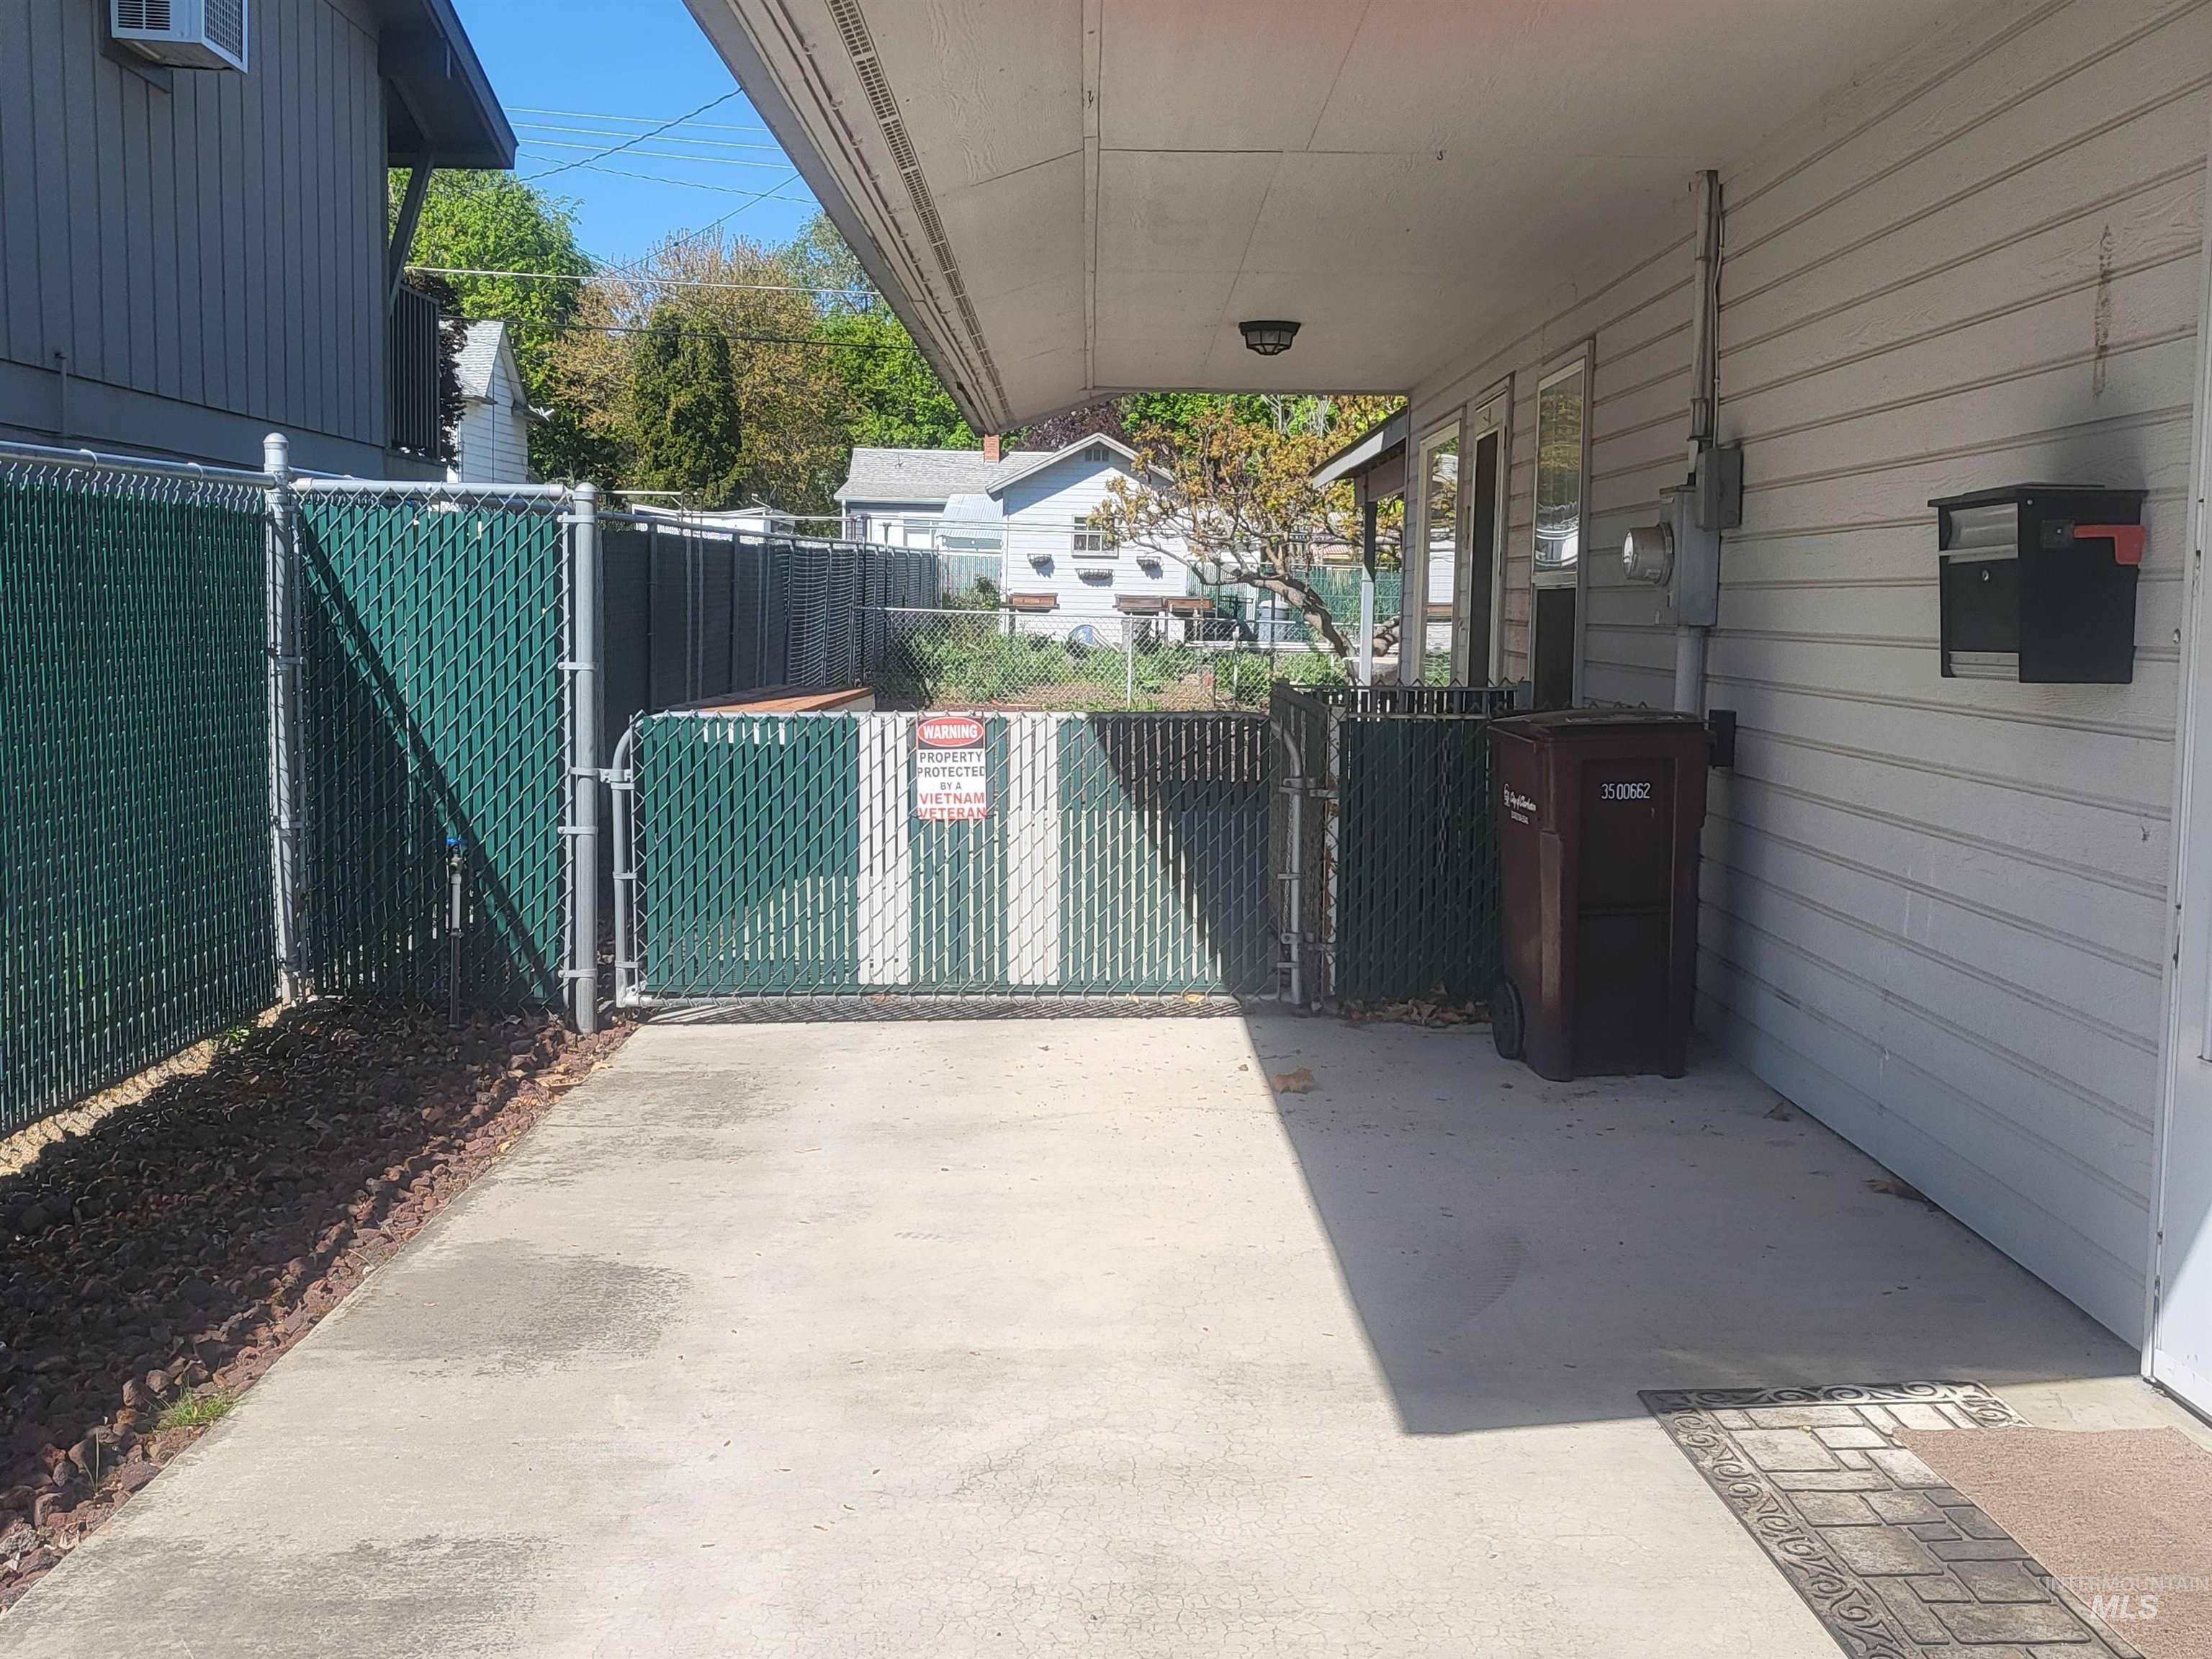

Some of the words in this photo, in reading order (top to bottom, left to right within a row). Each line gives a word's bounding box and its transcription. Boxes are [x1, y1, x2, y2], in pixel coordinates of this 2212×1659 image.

[923, 724, 978, 739] WARNING
[920, 751, 983, 763] PROPERTY
[917, 766, 985, 778] PROTECTED
[920, 792, 984, 804] VIETNAM
[919, 807, 986, 819] VETERAN
